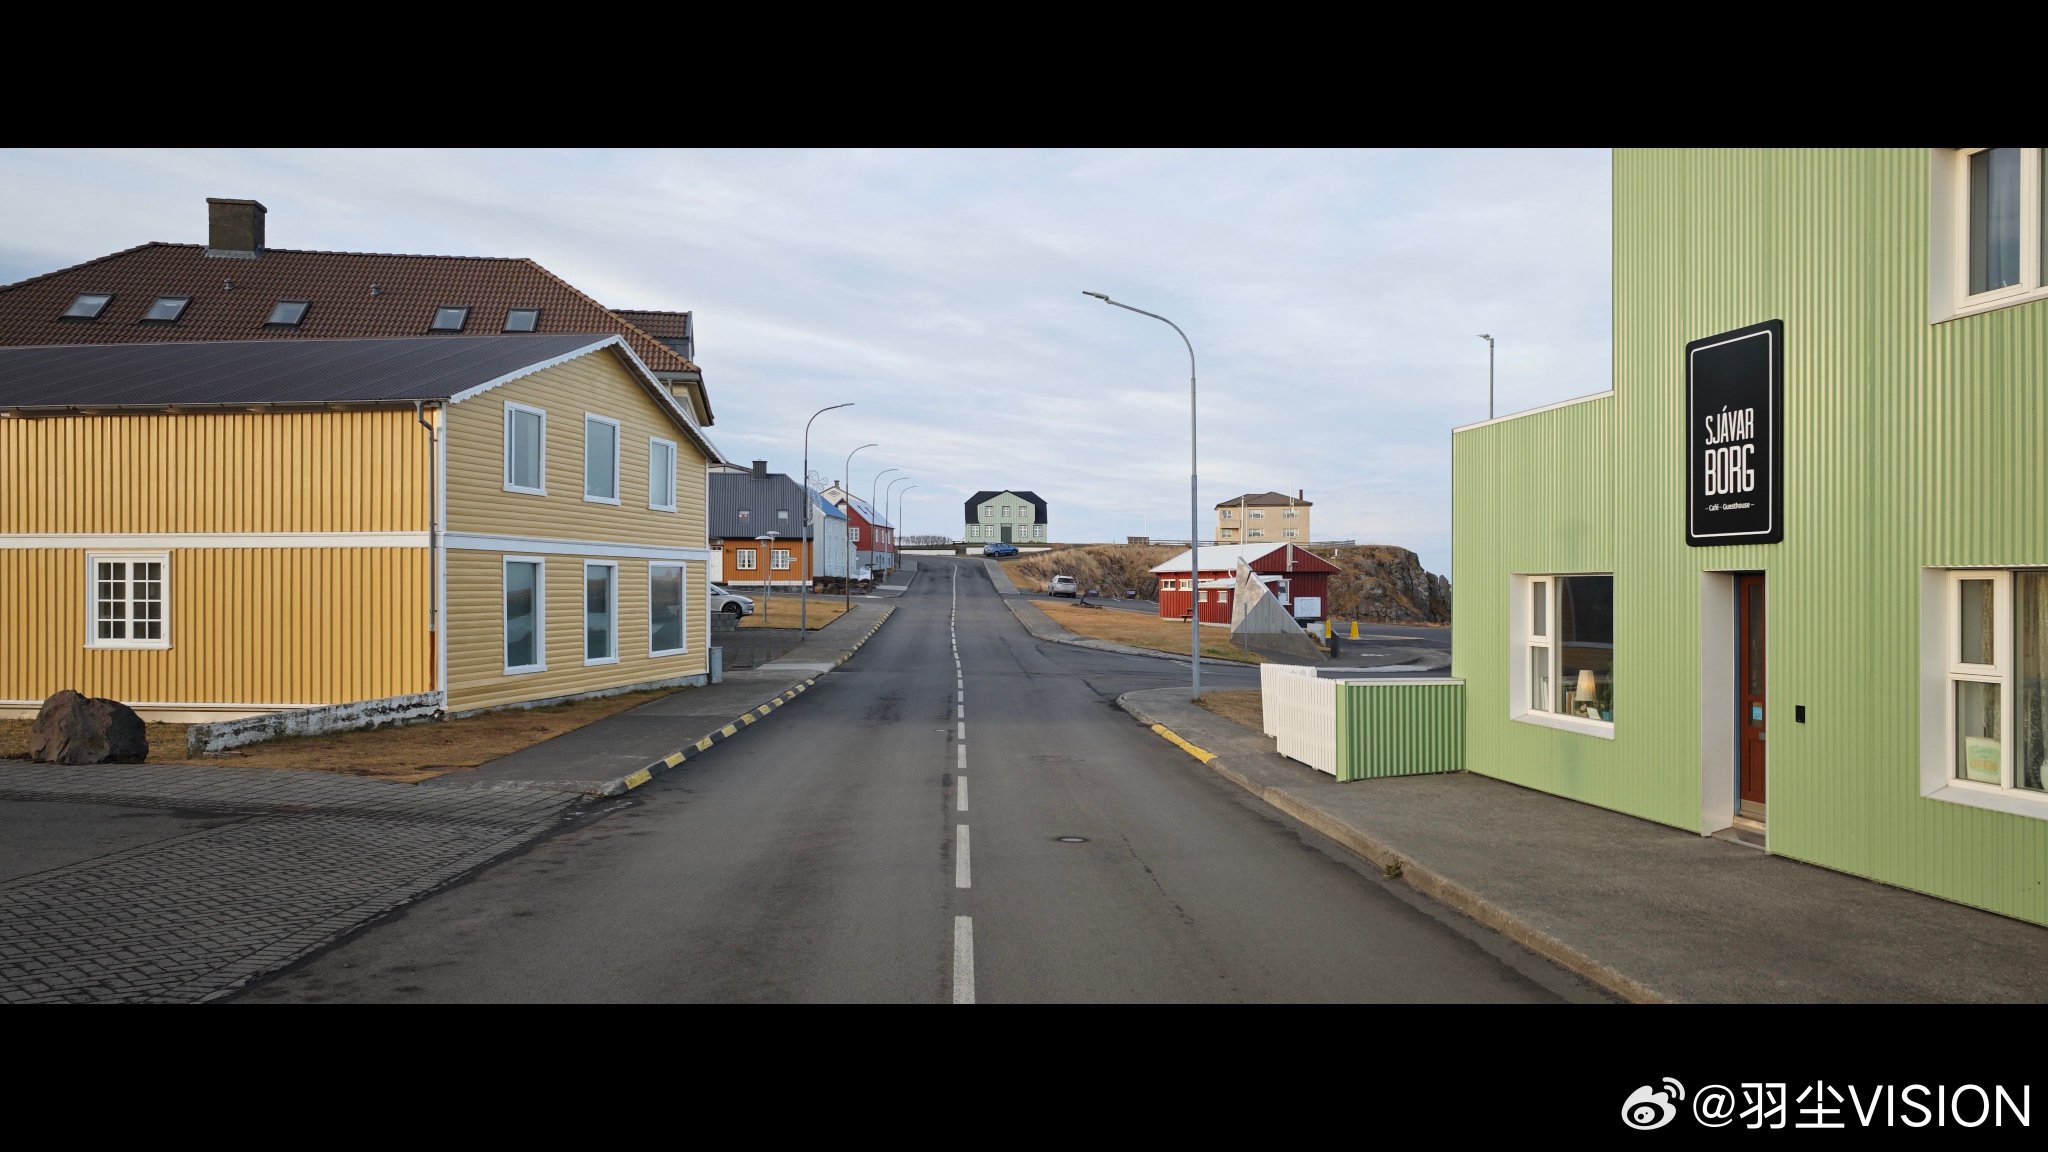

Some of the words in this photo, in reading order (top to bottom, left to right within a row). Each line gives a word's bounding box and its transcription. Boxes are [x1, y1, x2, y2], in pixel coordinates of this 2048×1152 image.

[1705, 405, 1755, 446] SJÁVAR
[1705, 443, 1755, 496] BORG
[1971, 759, 1997, 772] OPEN
